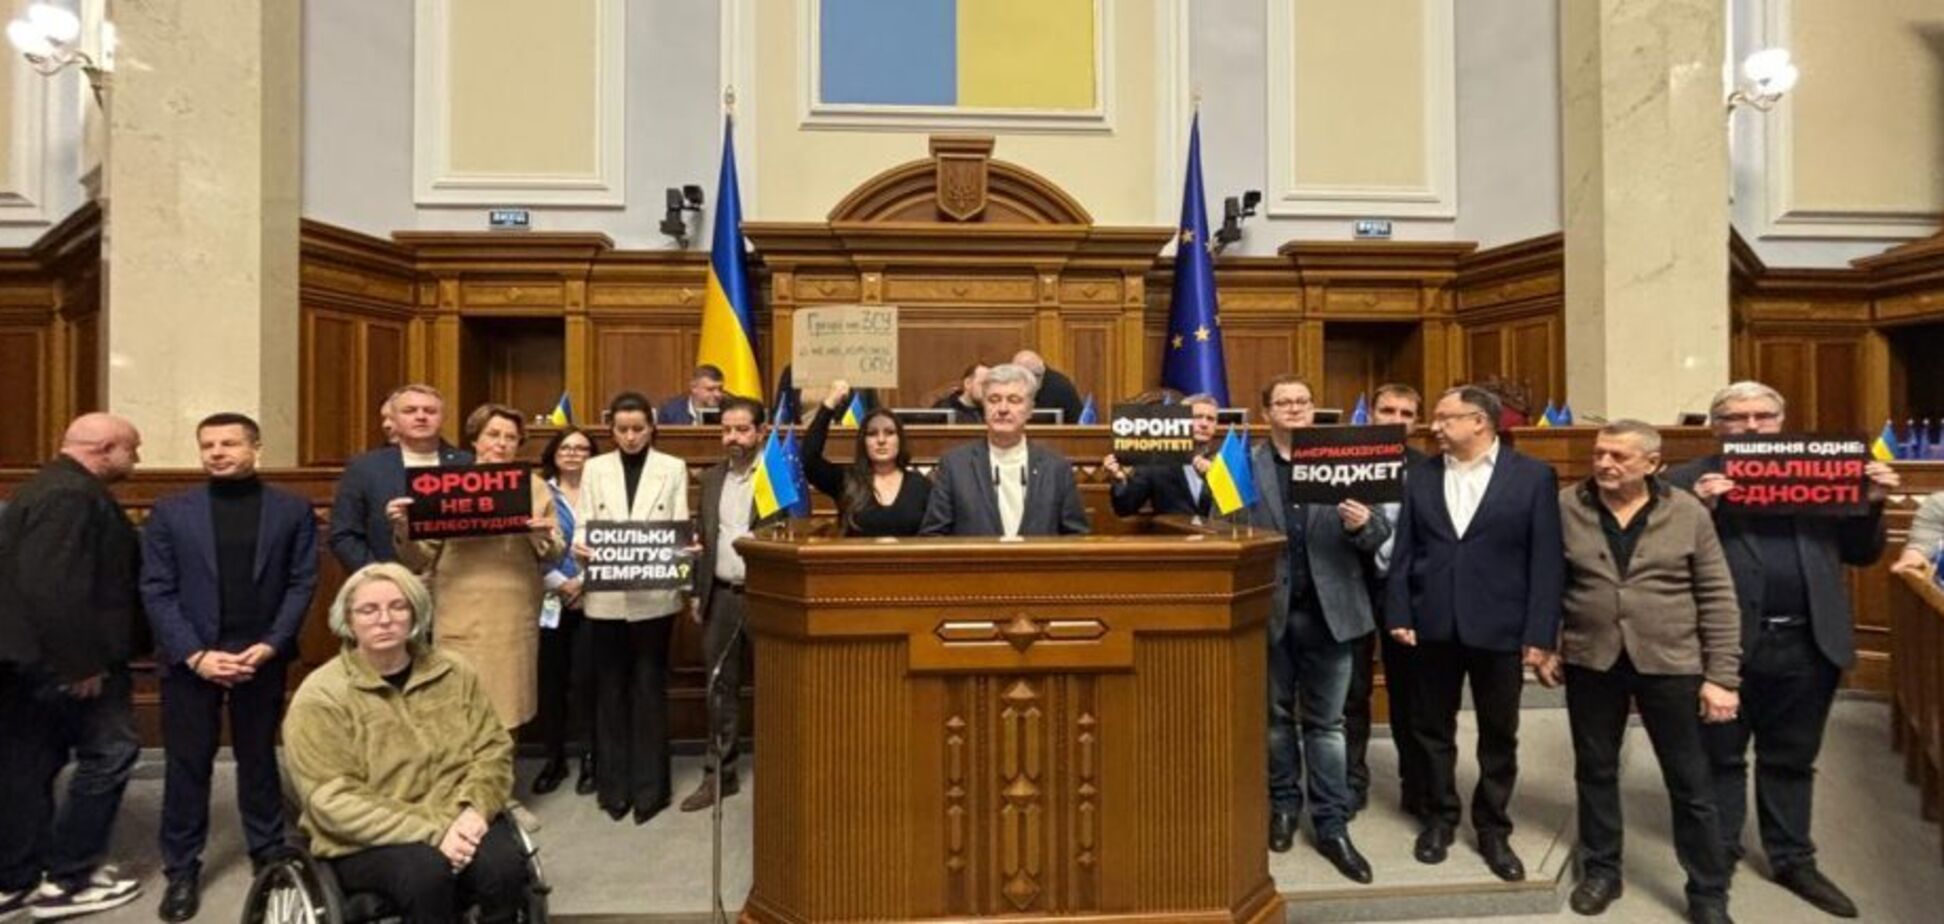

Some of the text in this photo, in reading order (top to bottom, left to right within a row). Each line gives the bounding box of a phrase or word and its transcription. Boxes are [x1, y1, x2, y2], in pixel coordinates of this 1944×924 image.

[1112, 416, 1193, 437] ФРОНТ
[1723, 441, 1865, 455] РІШЕННЯ ОДНЕ:
[1292, 461, 1403, 486] БЮДЖЕТ
[1726, 460, 1862, 479] КОАЛІЦІЯ
[412, 470, 523, 495] ФРОНТ
[1727, 484, 1859, 505] ЄДНОСТІ
[441, 496, 495, 513] НЕ В
[590, 529, 676, 544] СКІЛЬКИ
[590, 547, 674, 562] КОШТУЄ
[588, 564, 690, 581] ТЕМРЯВА?
